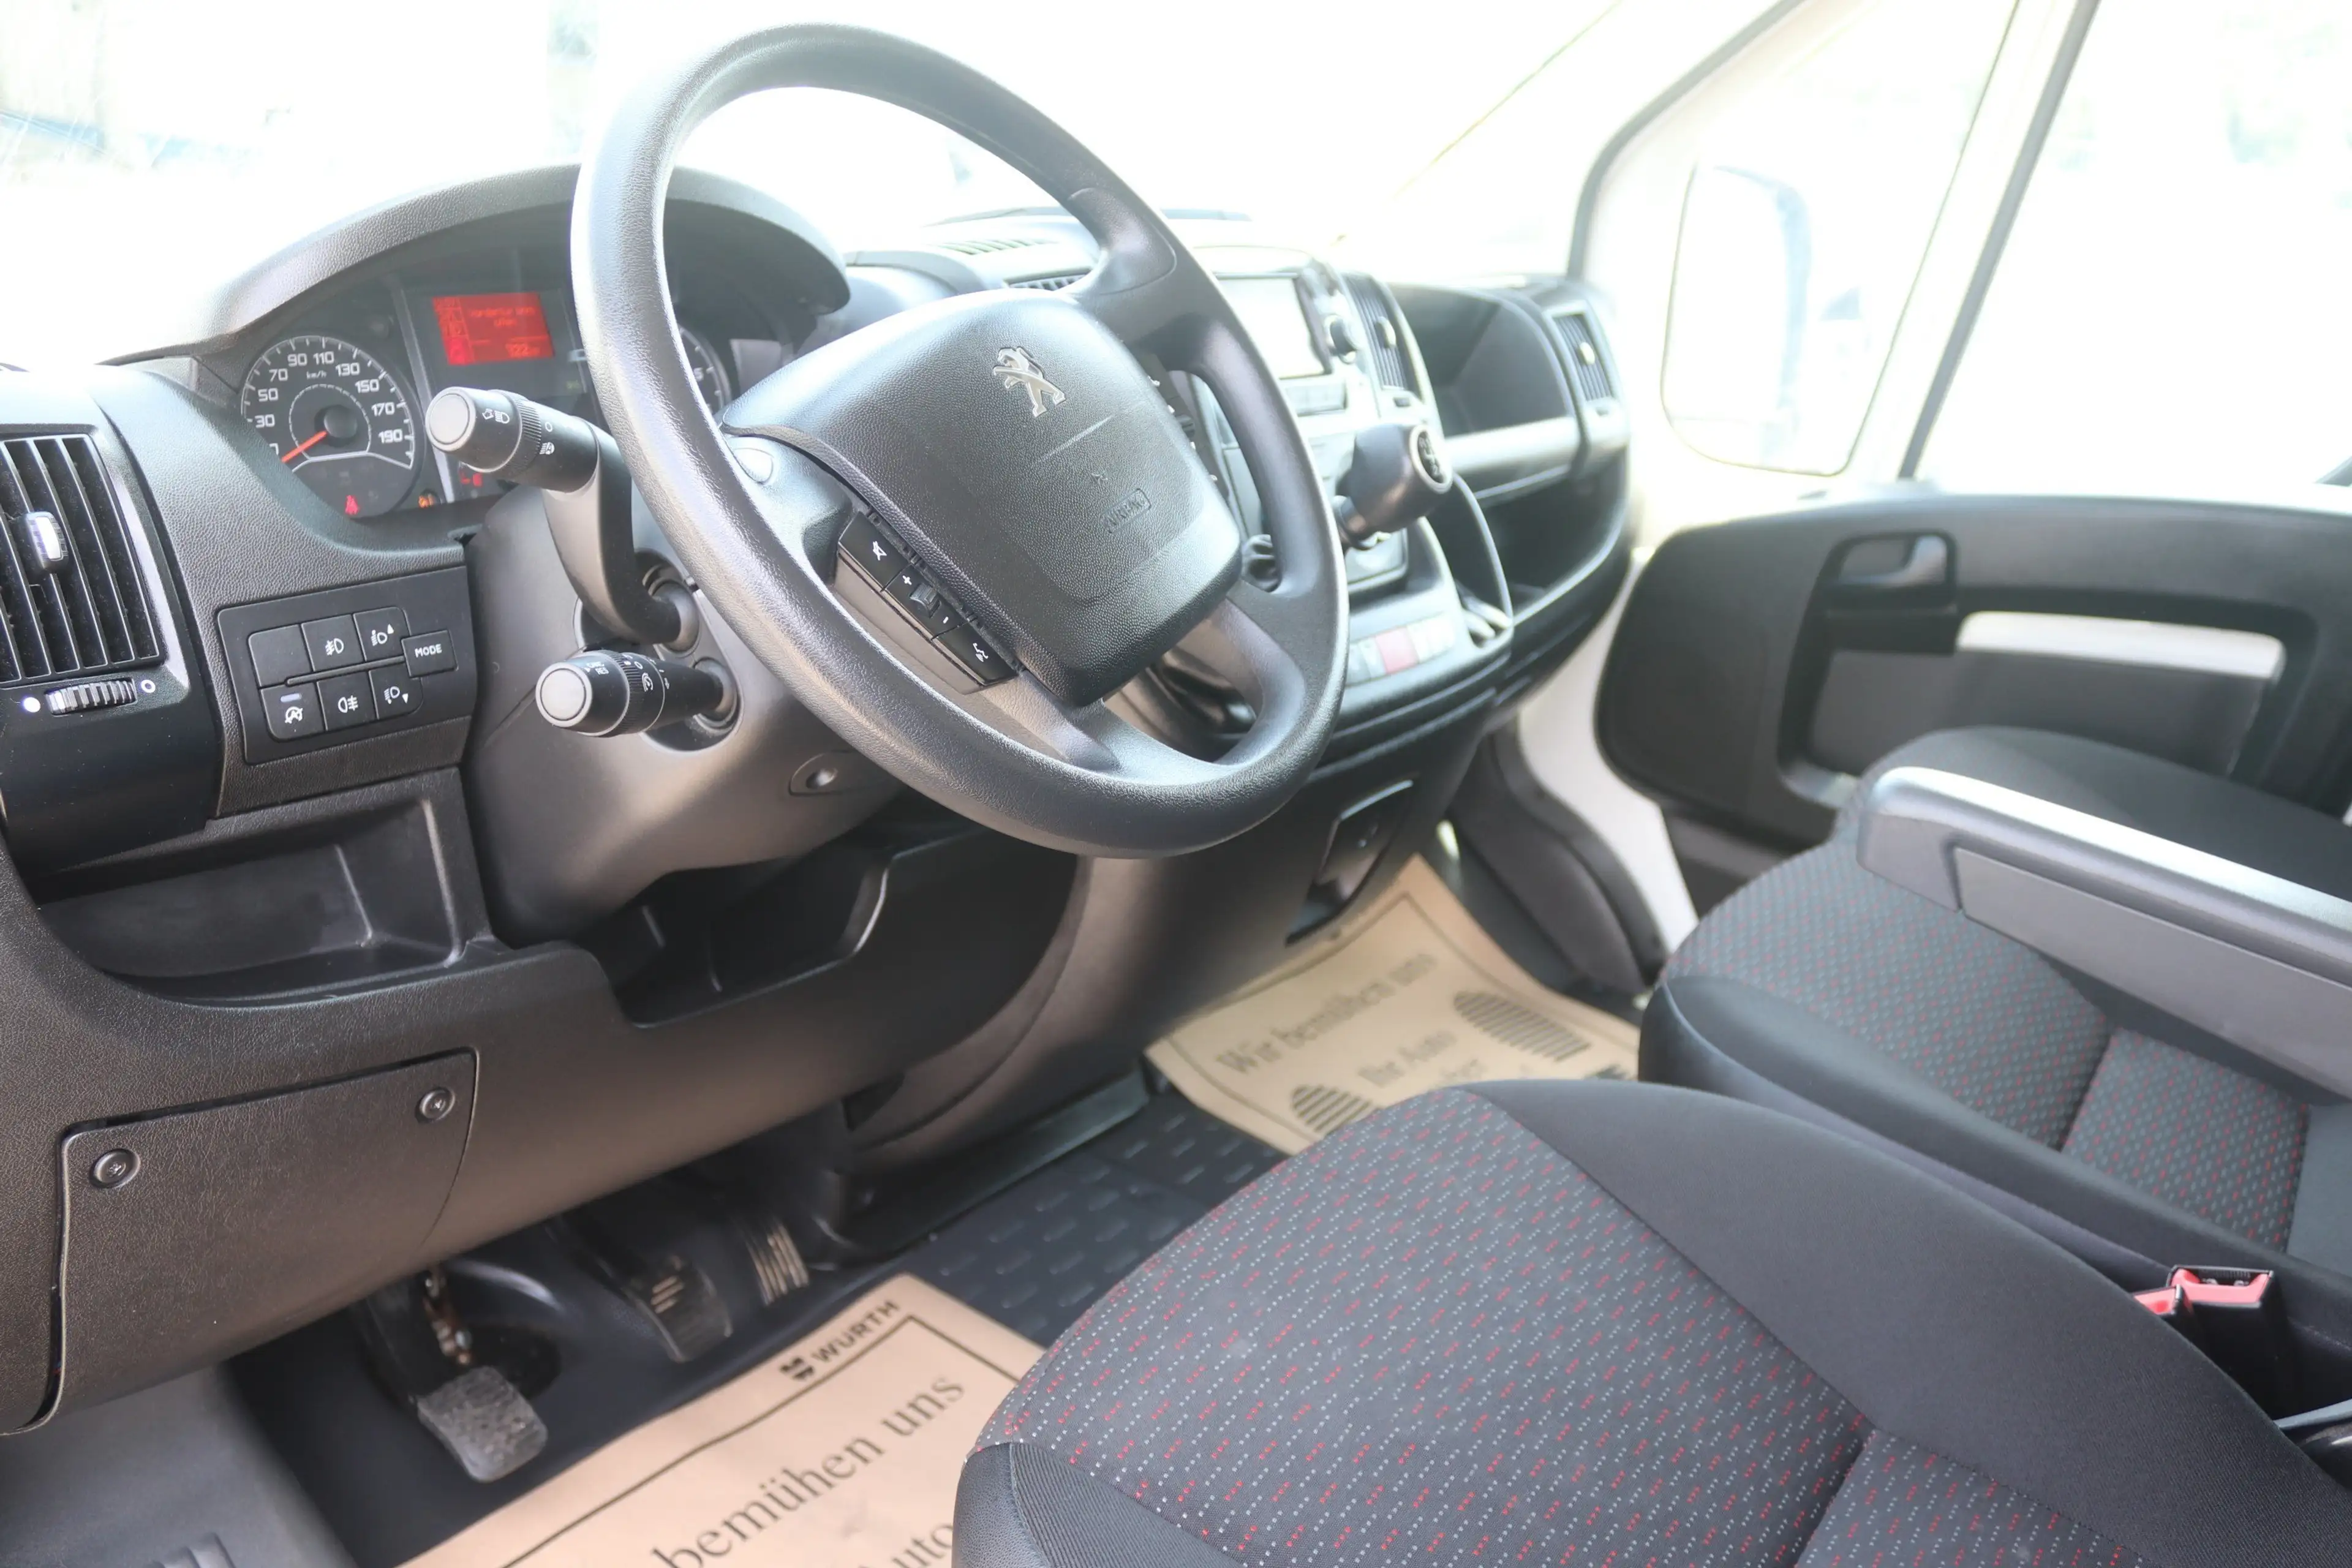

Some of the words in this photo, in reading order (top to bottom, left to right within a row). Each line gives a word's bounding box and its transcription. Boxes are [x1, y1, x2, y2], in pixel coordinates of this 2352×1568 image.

[287, 353, 307, 367] 90
[313, 351, 334, 364] 110
[269, 368, 288, 382] 70
[306, 370, 327, 380] km/h
[336, 363, 360, 377] 130
[355, 379, 380, 393] 150
[258, 388, 278, 402] 50
[371, 402, 395, 417] 170
[255, 414, 275, 428] 30
[378, 429, 403, 443] 190
[415, 643, 443, 658] MODE
[652, 1436, 886, 1568] bemühen
[881, 1376, 965, 1437] uns
[858, 1524, 954, 1568] uto
